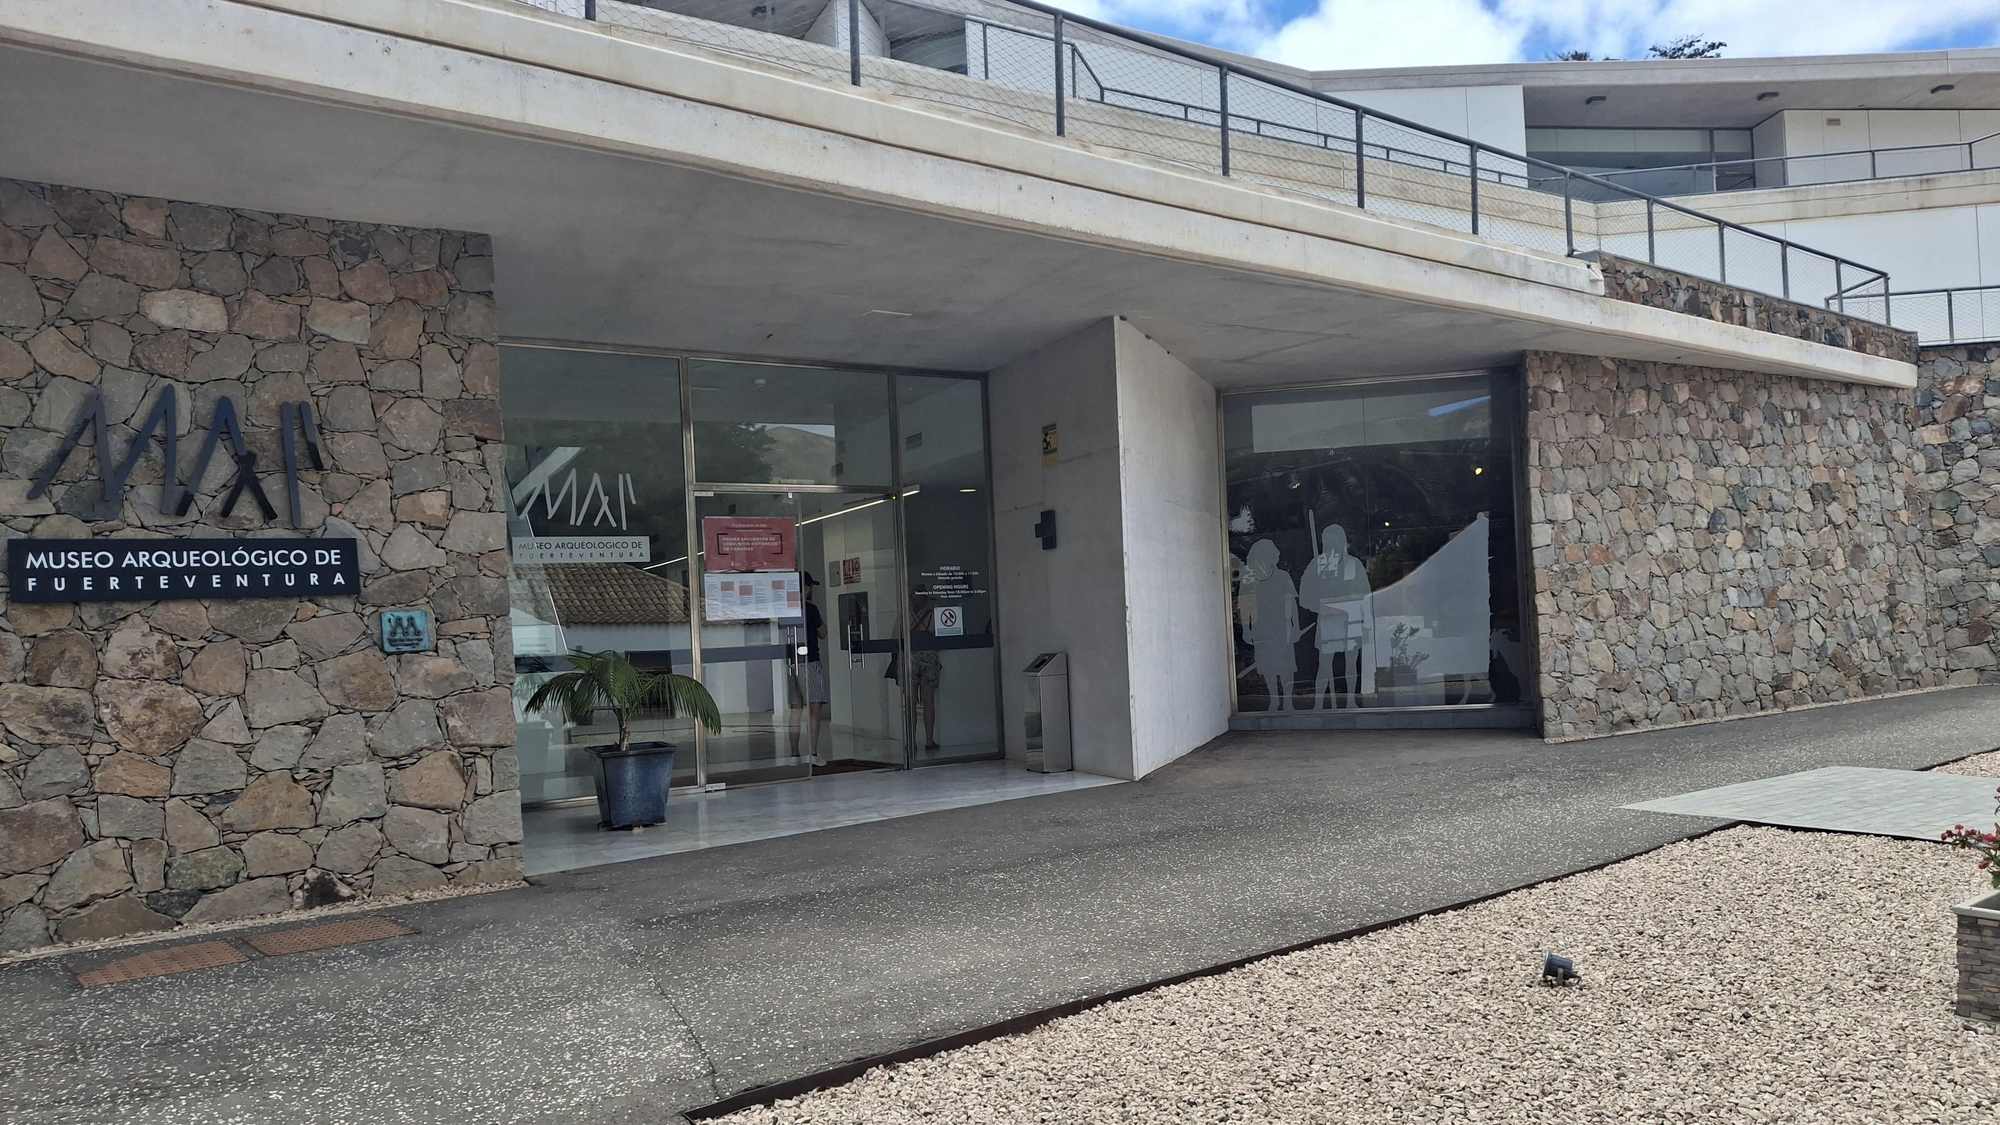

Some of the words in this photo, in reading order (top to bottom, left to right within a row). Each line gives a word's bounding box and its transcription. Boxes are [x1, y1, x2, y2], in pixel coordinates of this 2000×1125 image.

[632, 541, 642, 549] DE
[25, 550, 114, 570] MUSEO
[121, 546, 308, 569] ARQUEOLÓGICO
[314, 549, 342, 566] DE
[27, 572, 346, 592] FUERTEVENTURA
